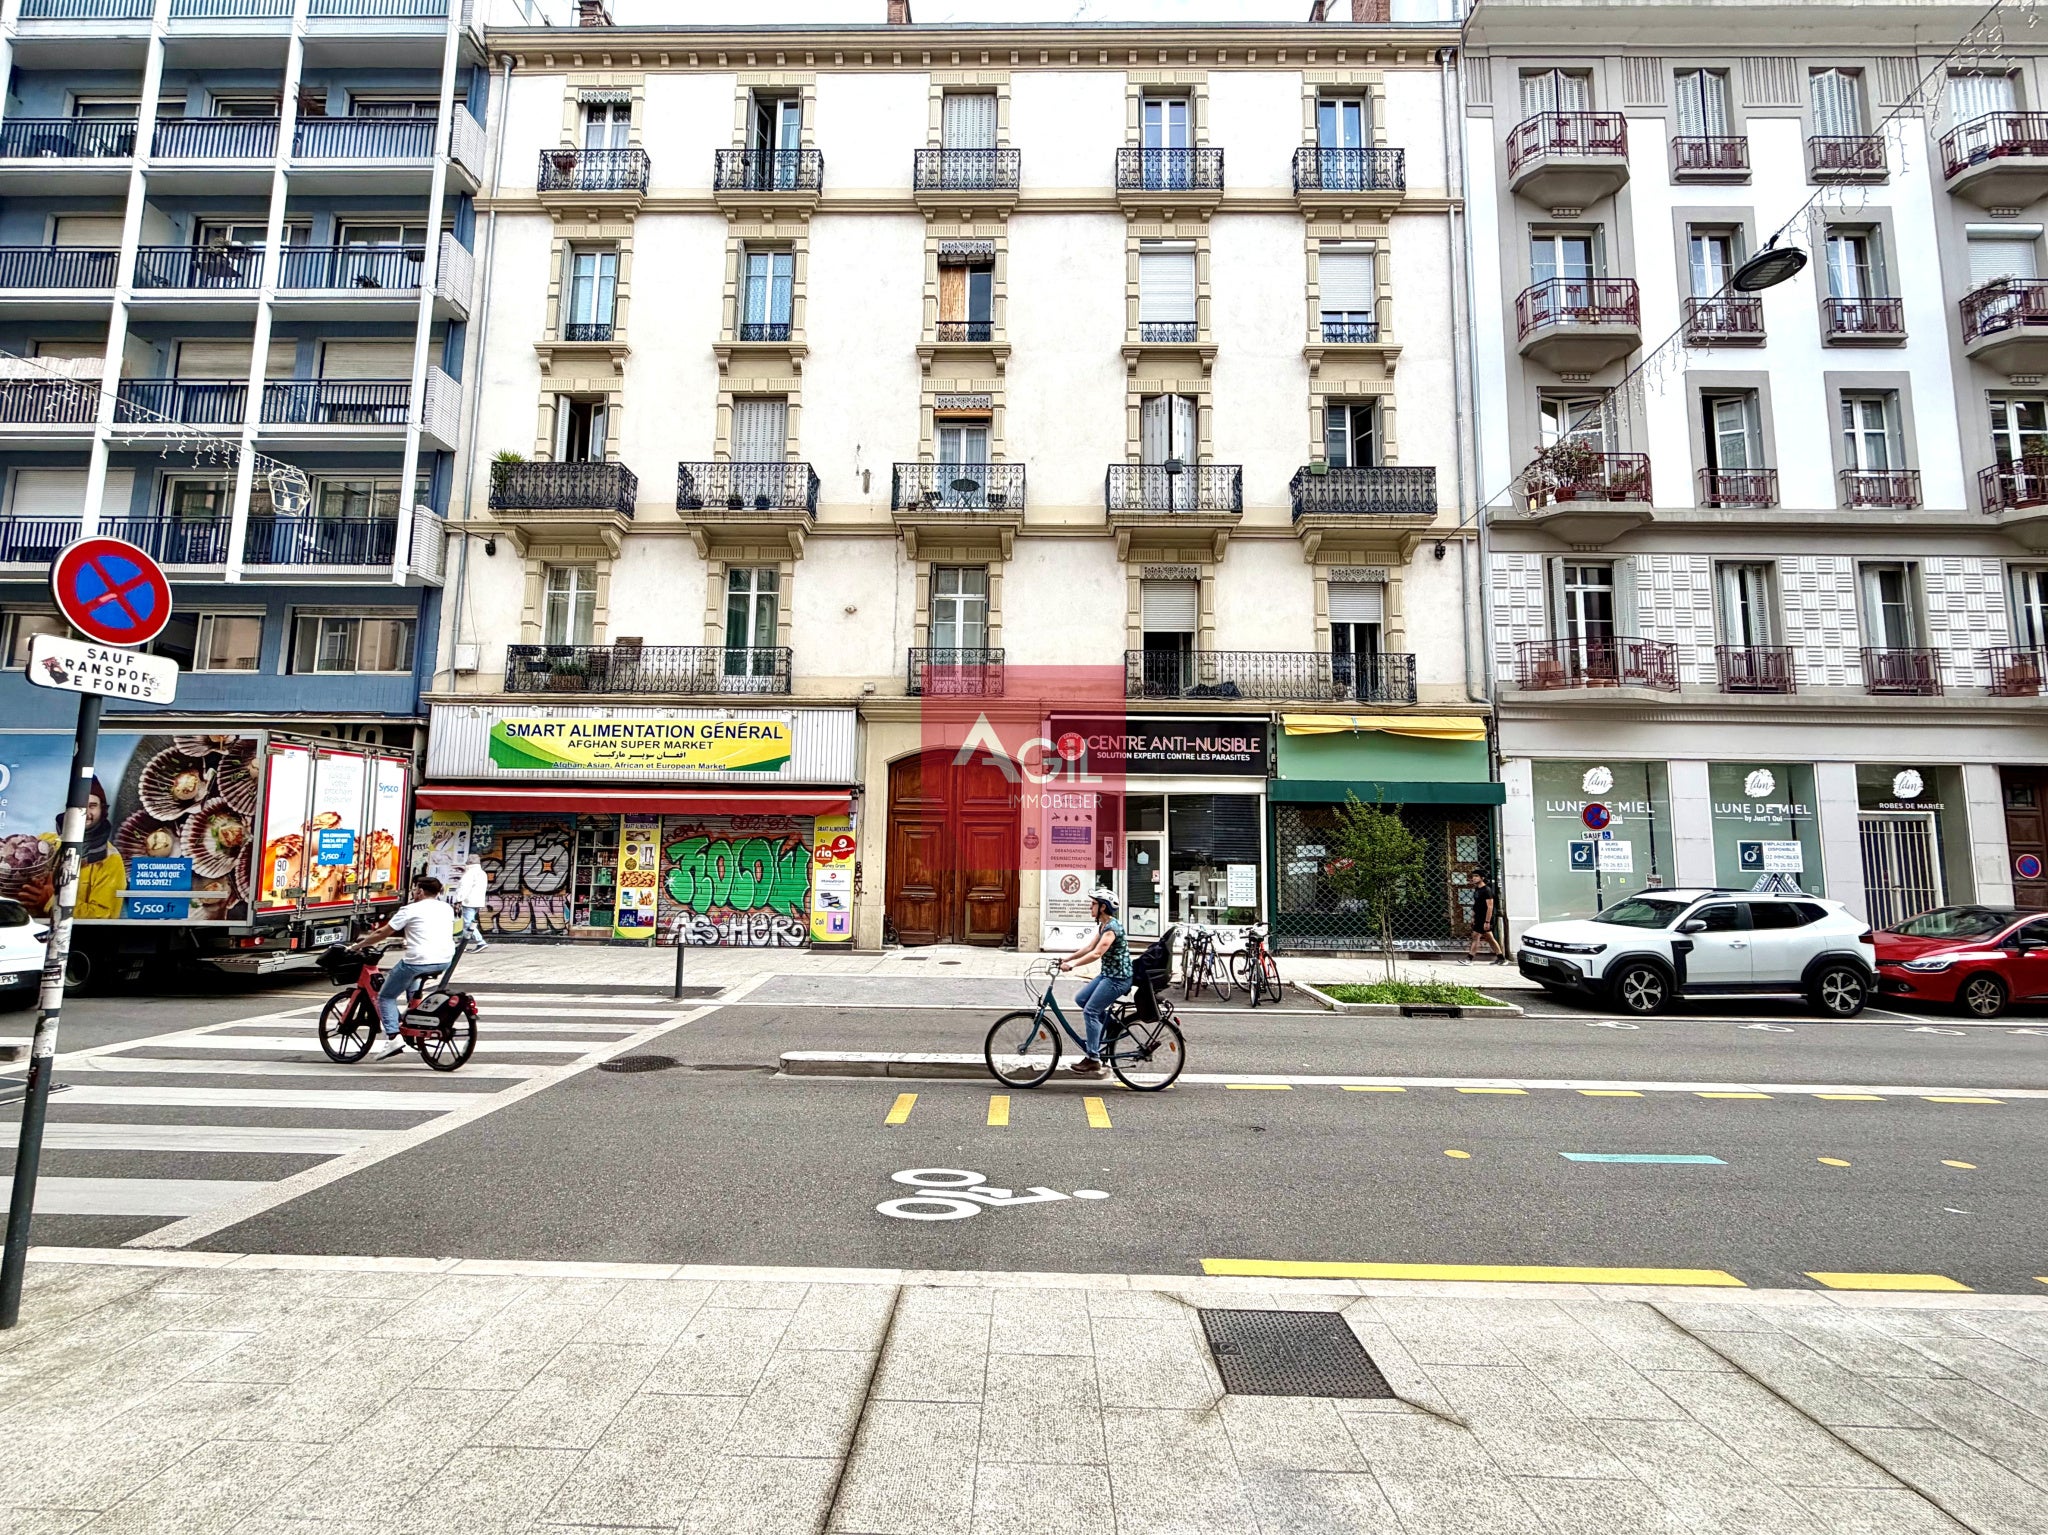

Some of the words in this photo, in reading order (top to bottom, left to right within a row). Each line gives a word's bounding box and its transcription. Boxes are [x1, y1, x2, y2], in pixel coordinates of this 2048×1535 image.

[87, 648, 135, 665] SAUF
[64, 658, 153, 684] RANSPOR
[93, 678, 152, 697] FONDS
[506, 723, 566, 738] SMART
[570, 724, 695, 738] ALIMENTATION
[701, 721, 783, 739] GÉNÉRAL
[568, 740, 617, 749] AFGHAN
[620, 740, 660, 749] SUPER
[664, 741, 714, 750] MARKET
[1087, 735, 1147, 751] CENTRE
[1150, 736, 1261, 753] ANTI-NUISIBLE
[655, 763, 697, 771] European
[378, 783, 399, 794] Sysco
[1618, 802, 1656, 813] MIEL
[1714, 803, 1751, 813] LUNE
[1755, 804, 1774, 814] DE
[1778, 804, 1812, 815] MIEL
[1744, 815, 1752, 823] by
[1583, 832, 1602, 840] SAUF
[816, 847, 832, 857] ria
[276, 860, 287, 871] 90
[168, 871, 180, 879] QUE
[275, 875, 286, 887] 80
